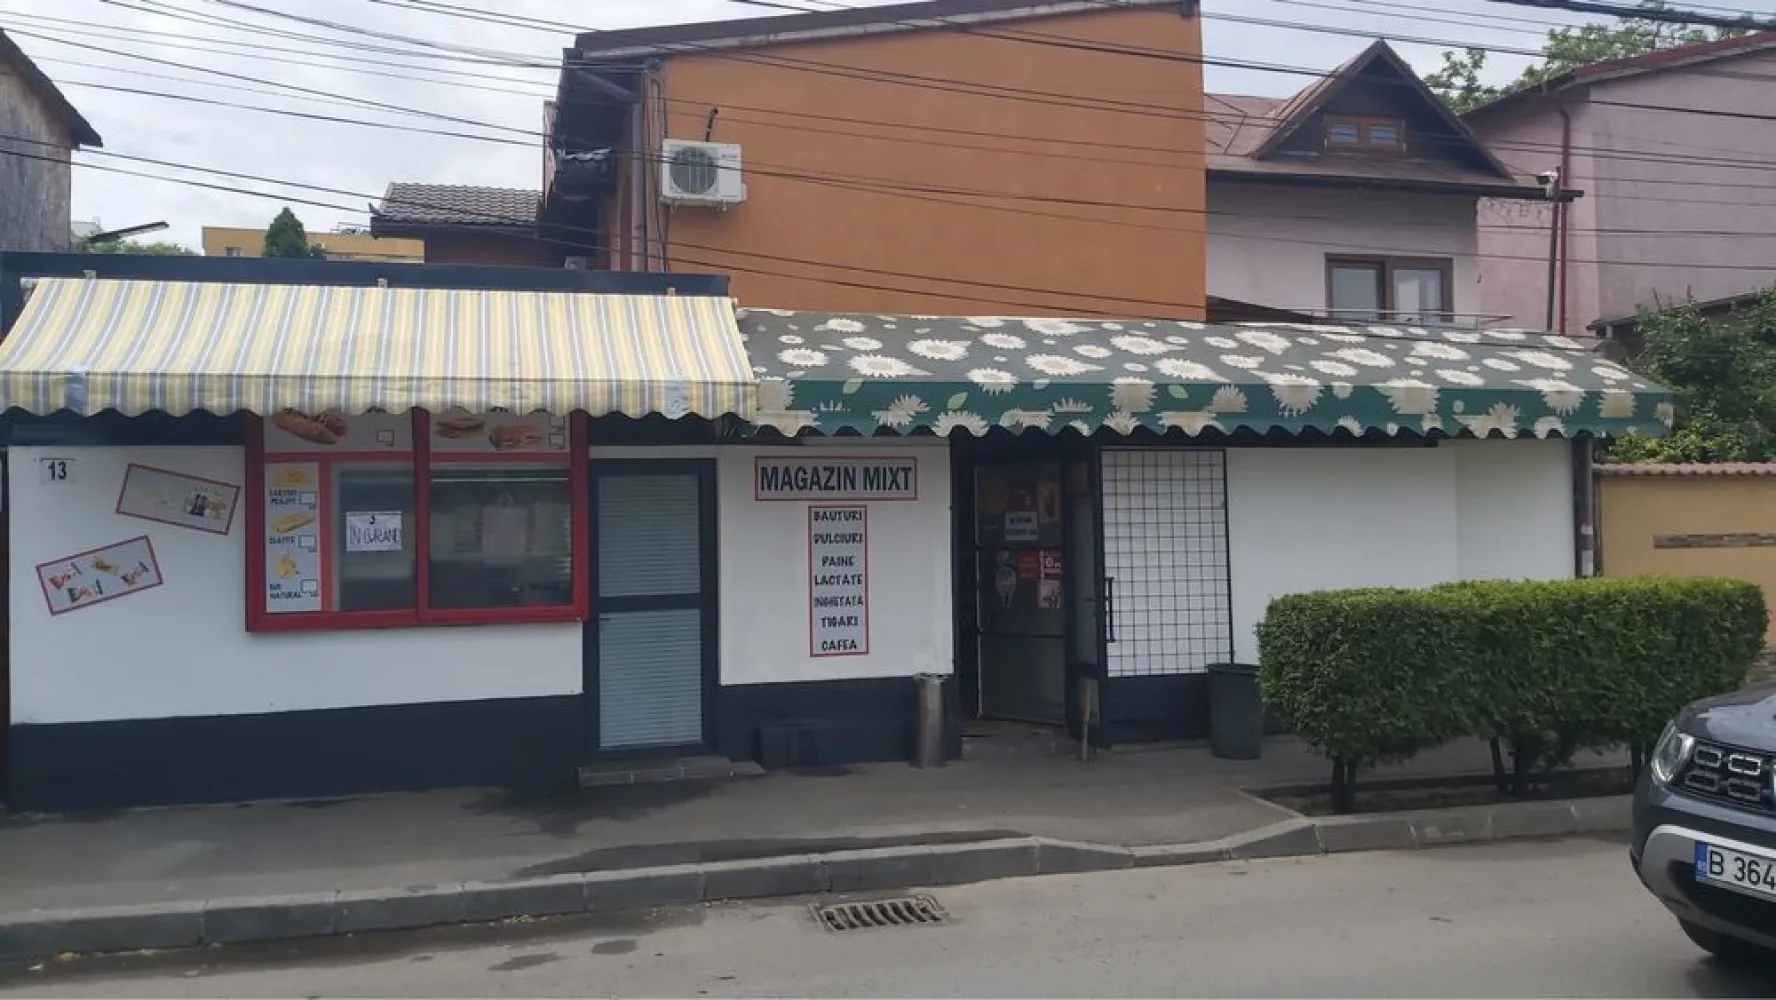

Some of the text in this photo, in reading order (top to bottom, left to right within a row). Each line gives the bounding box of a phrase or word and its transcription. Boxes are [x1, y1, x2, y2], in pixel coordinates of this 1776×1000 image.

[48, 461, 67, 481] 13
[760, 466, 912, 491] MAGAZIN MIXT
[813, 510, 863, 522] BAUTURI
[813, 532, 863, 545] DULCIURI
[821, 555, 856, 568] PAINE
[813, 573, 864, 587] LACTATE
[820, 615, 859, 628] TIGARI
[821, 639, 858, 651] CAFEA
[1709, 850, 1724, 876] B
[1733, 856, 1776, 890] 364
